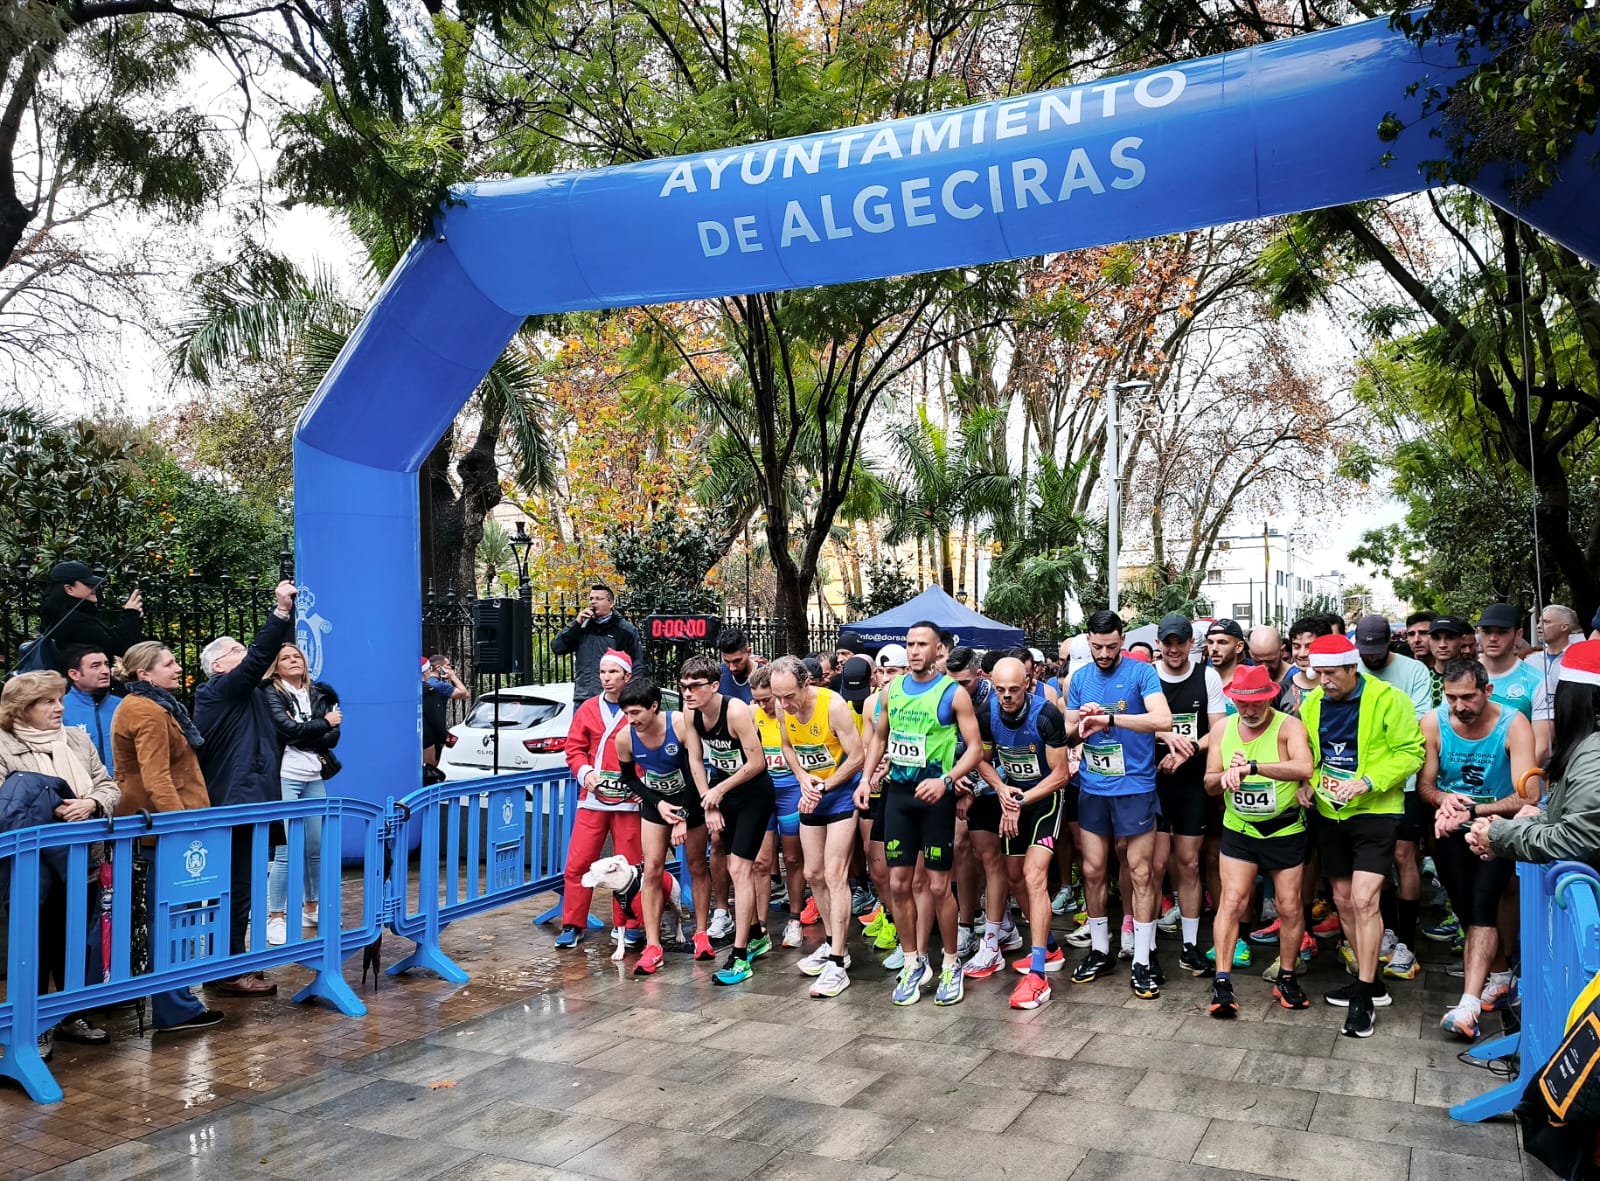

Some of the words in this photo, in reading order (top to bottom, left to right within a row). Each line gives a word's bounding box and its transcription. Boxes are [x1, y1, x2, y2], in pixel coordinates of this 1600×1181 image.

[659, 69, 1187, 197] AYUNTAMIENTO
[697, 215, 763, 257] DE
[780, 136, 1146, 248] ALGECIRAS
[891, 741, 920, 757] 709
[711, 758, 737, 769] 787
[799, 753, 827, 765] 706
[1092, 754, 1110, 768] 51
[650, 779, 680, 790] 592
[1234, 791, 1269, 806] 604
